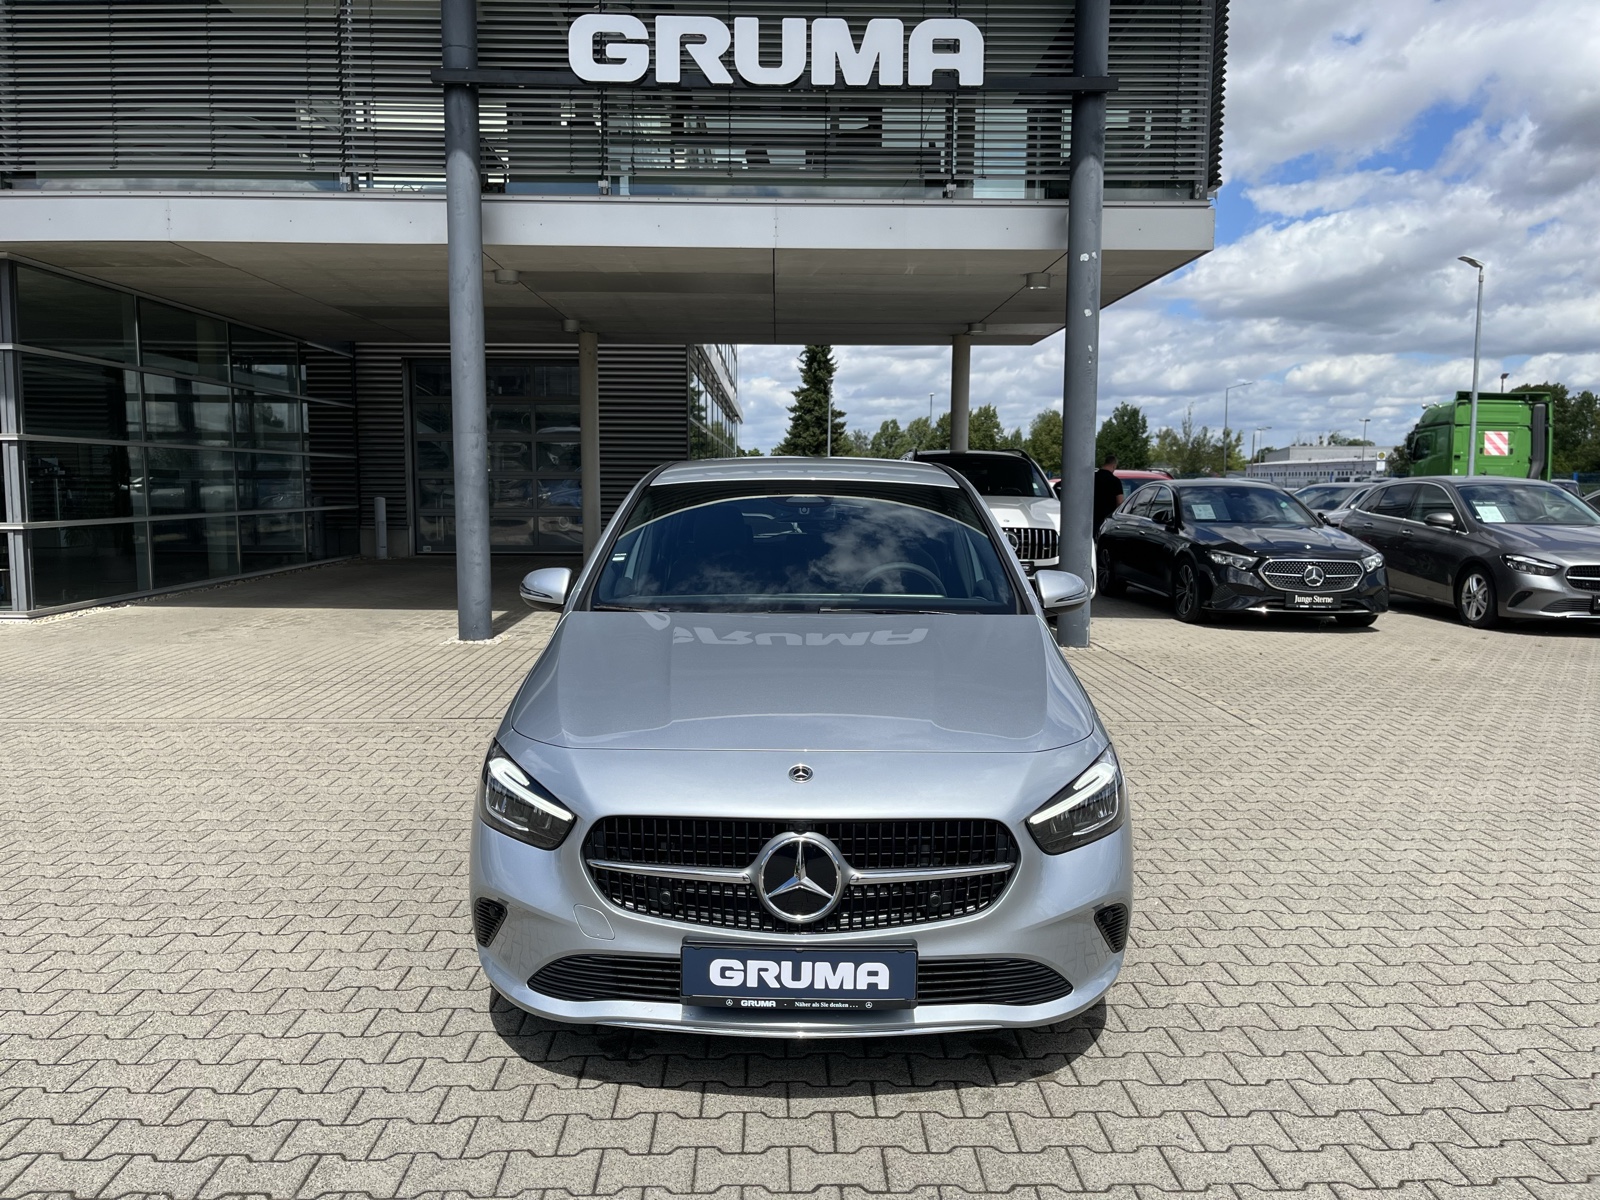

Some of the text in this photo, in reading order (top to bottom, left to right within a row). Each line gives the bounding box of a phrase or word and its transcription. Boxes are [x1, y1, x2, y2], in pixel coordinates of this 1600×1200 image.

[568, 14, 985, 87] GRUMA
[1294, 594, 1334, 604] Junge Sterne
[709, 958, 890, 990] GRUMA
[740, 1000, 776, 1008] GRUMA
